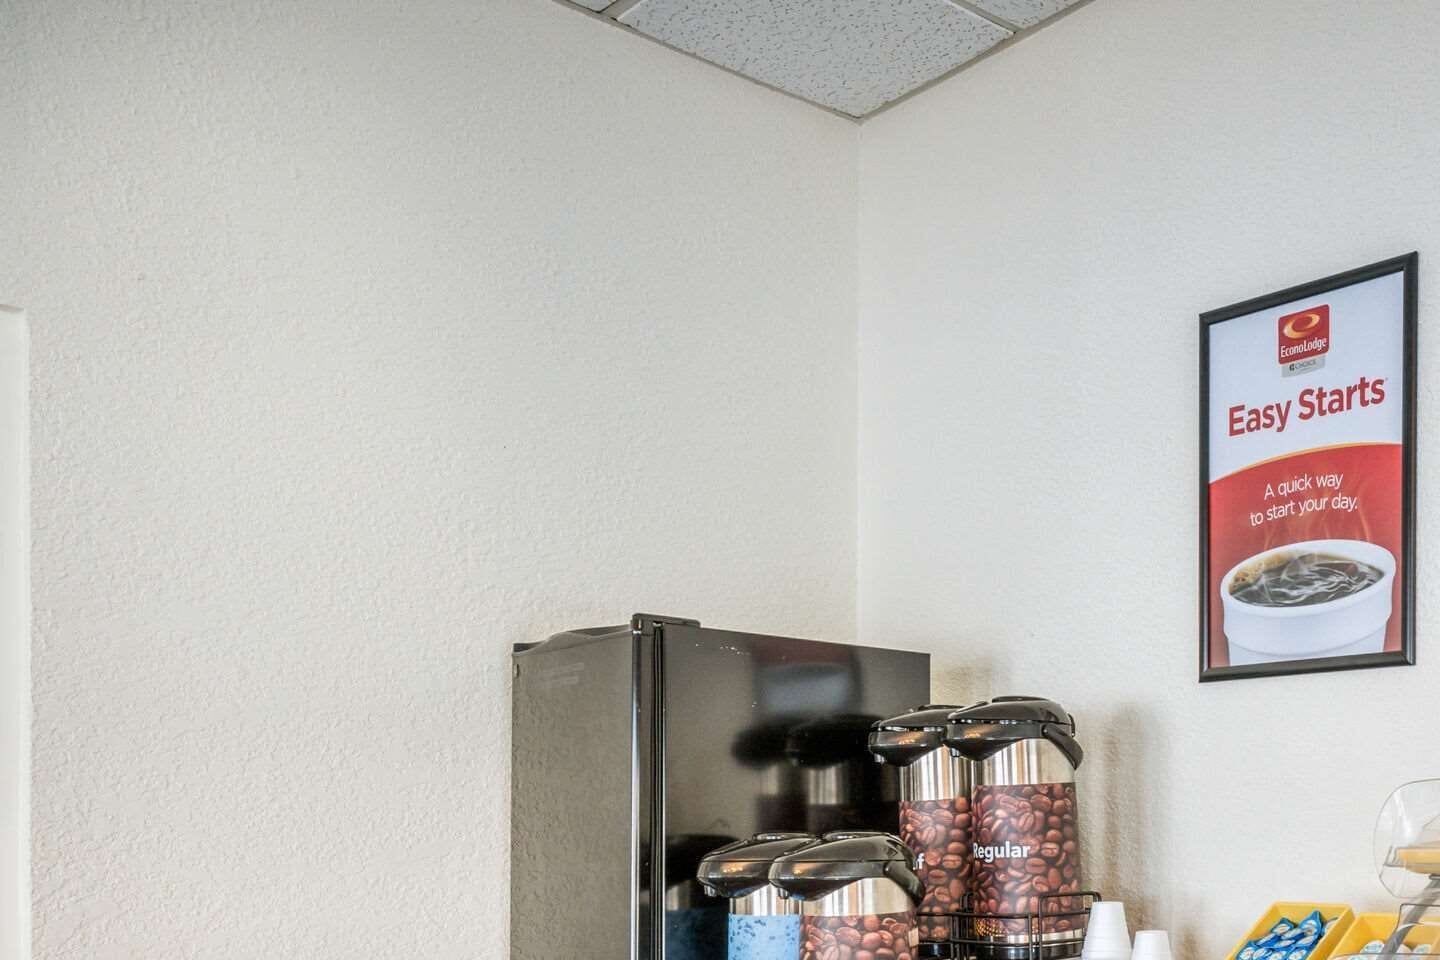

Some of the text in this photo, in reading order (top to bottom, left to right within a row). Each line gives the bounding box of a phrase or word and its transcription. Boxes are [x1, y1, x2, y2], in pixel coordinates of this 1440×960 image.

[1280, 337, 1327, 358] EconoLodge
[1228, 376, 1385, 437] Easy Starts
[1264, 473, 1344, 500] A quick way
[1249, 492, 1358, 527] to start your day.
[972, 841, 1031, 863] Regular
